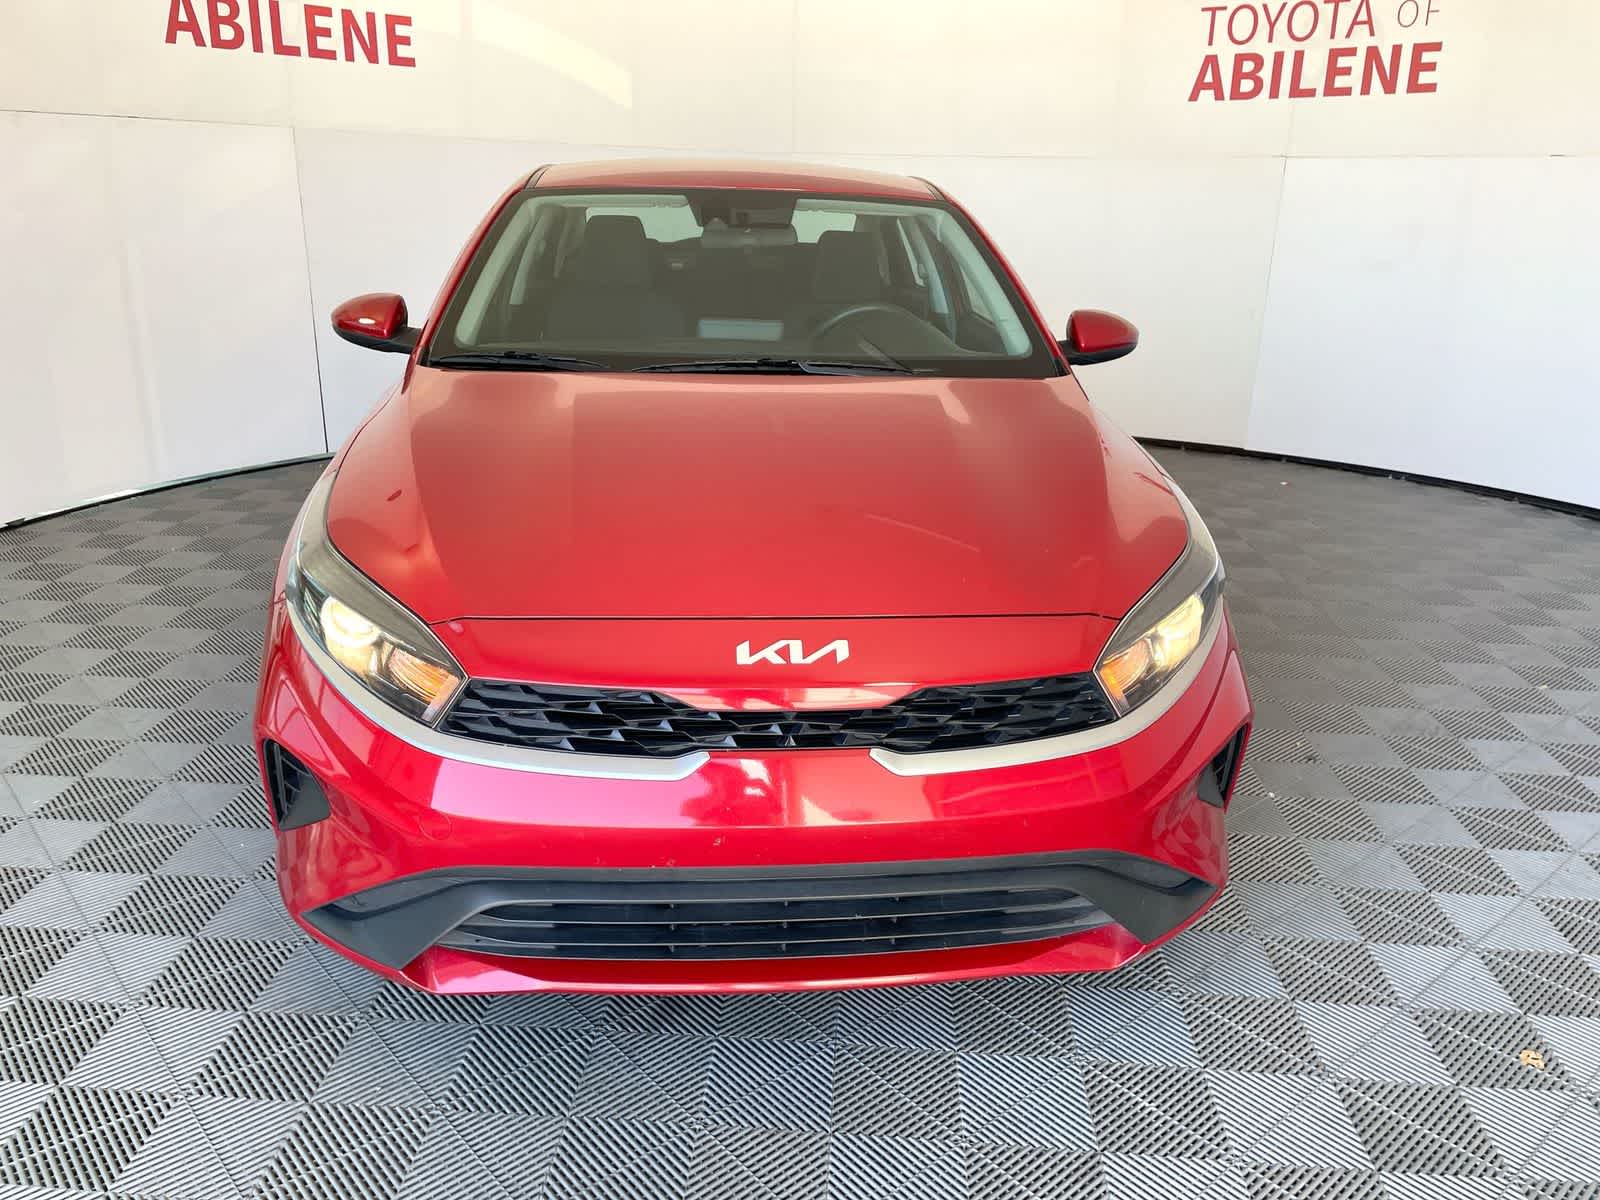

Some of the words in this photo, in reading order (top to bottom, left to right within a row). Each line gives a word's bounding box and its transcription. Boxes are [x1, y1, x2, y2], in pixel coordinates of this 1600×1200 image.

[1201, 0, 1376, 46] TOYOTA
[1187, 41, 1443, 101] ABILENE
[736, 639, 850, 664] KIA
